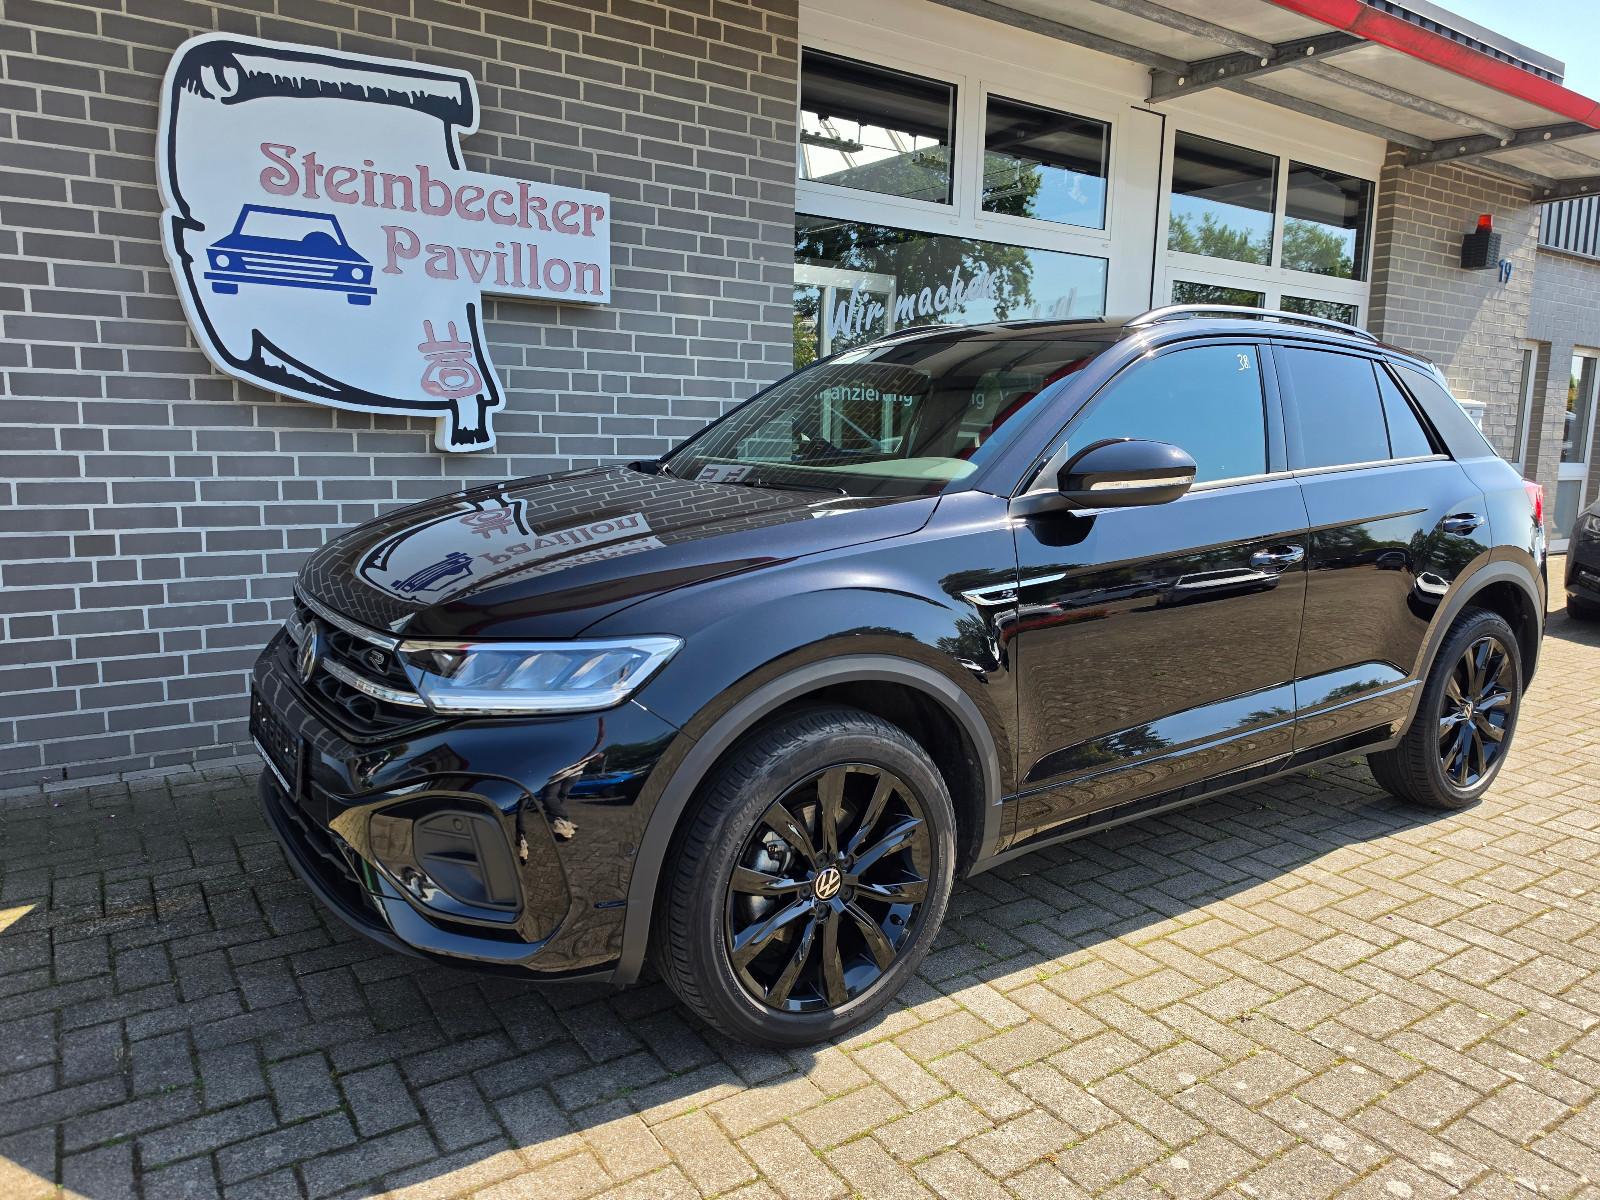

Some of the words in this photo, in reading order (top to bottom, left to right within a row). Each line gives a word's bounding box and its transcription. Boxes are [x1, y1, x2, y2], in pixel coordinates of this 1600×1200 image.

[259, 142, 605, 237] Steinbecker
[381, 225, 604, 296] Pavillon
[1498, 259, 1511, 283] 19
[827, 280, 885, 340] Wir
[894, 264, 999, 322] machen
